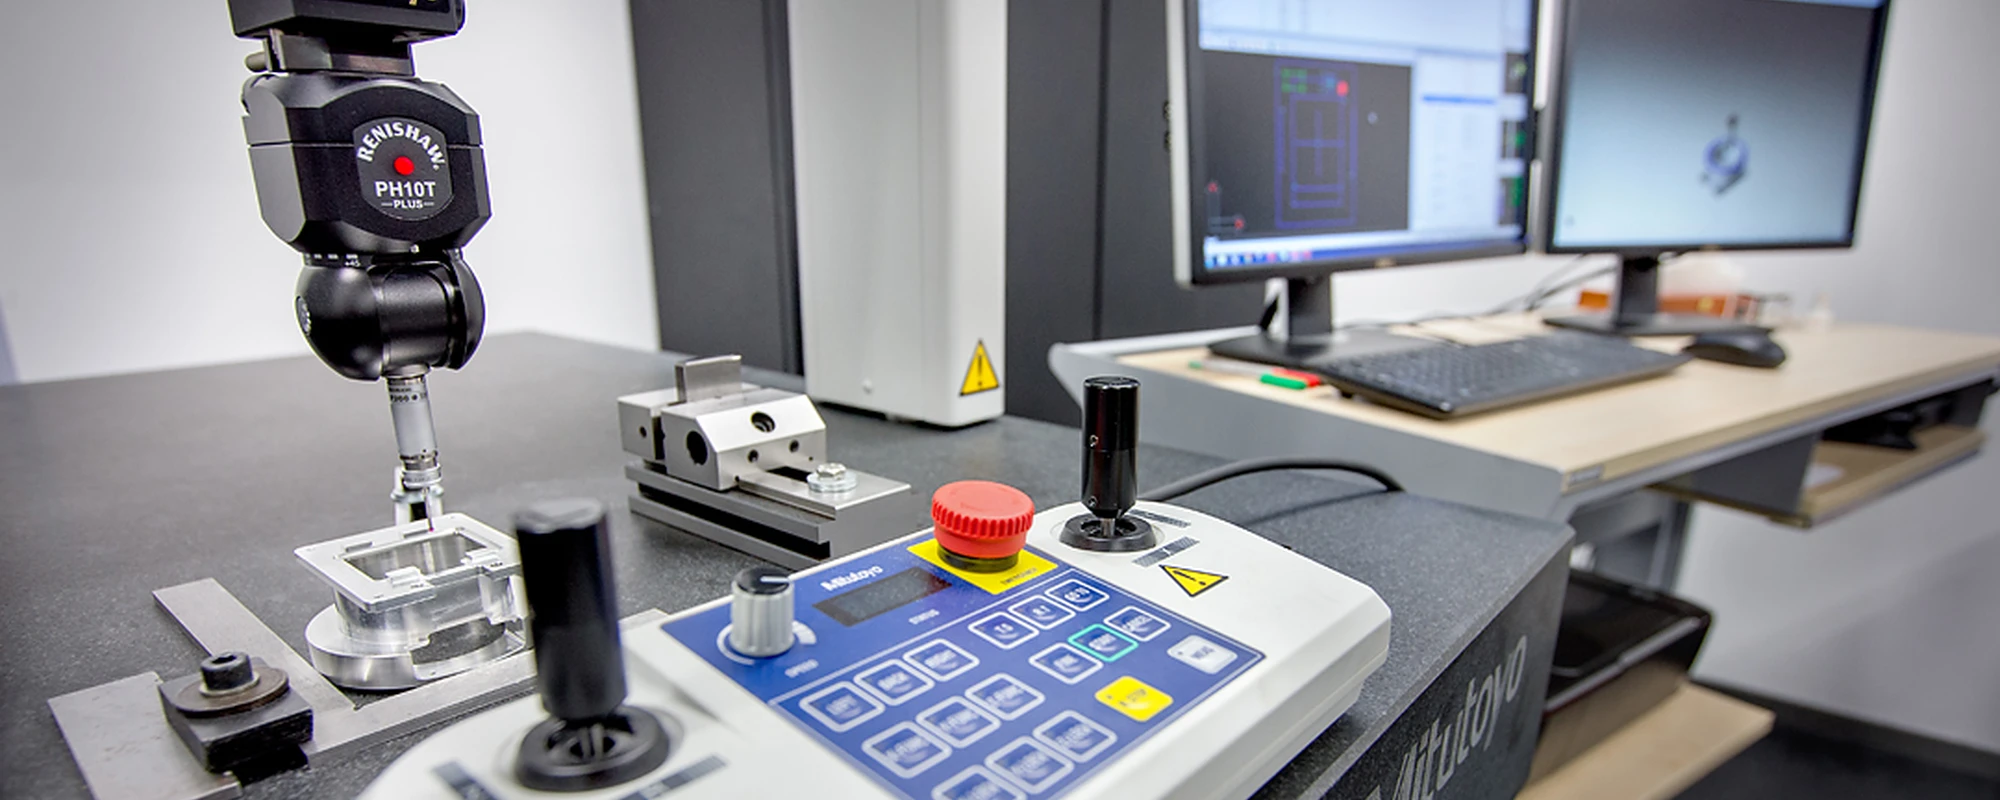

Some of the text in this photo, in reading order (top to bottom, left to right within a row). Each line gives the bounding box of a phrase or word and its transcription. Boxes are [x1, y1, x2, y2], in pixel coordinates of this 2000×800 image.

[357, 121, 446, 163] RENISHAW
[374, 181, 437, 198] PH10T
[392, 199, 424, 209] PLUS
[820, 565, 884, 591] Mitutoyo
